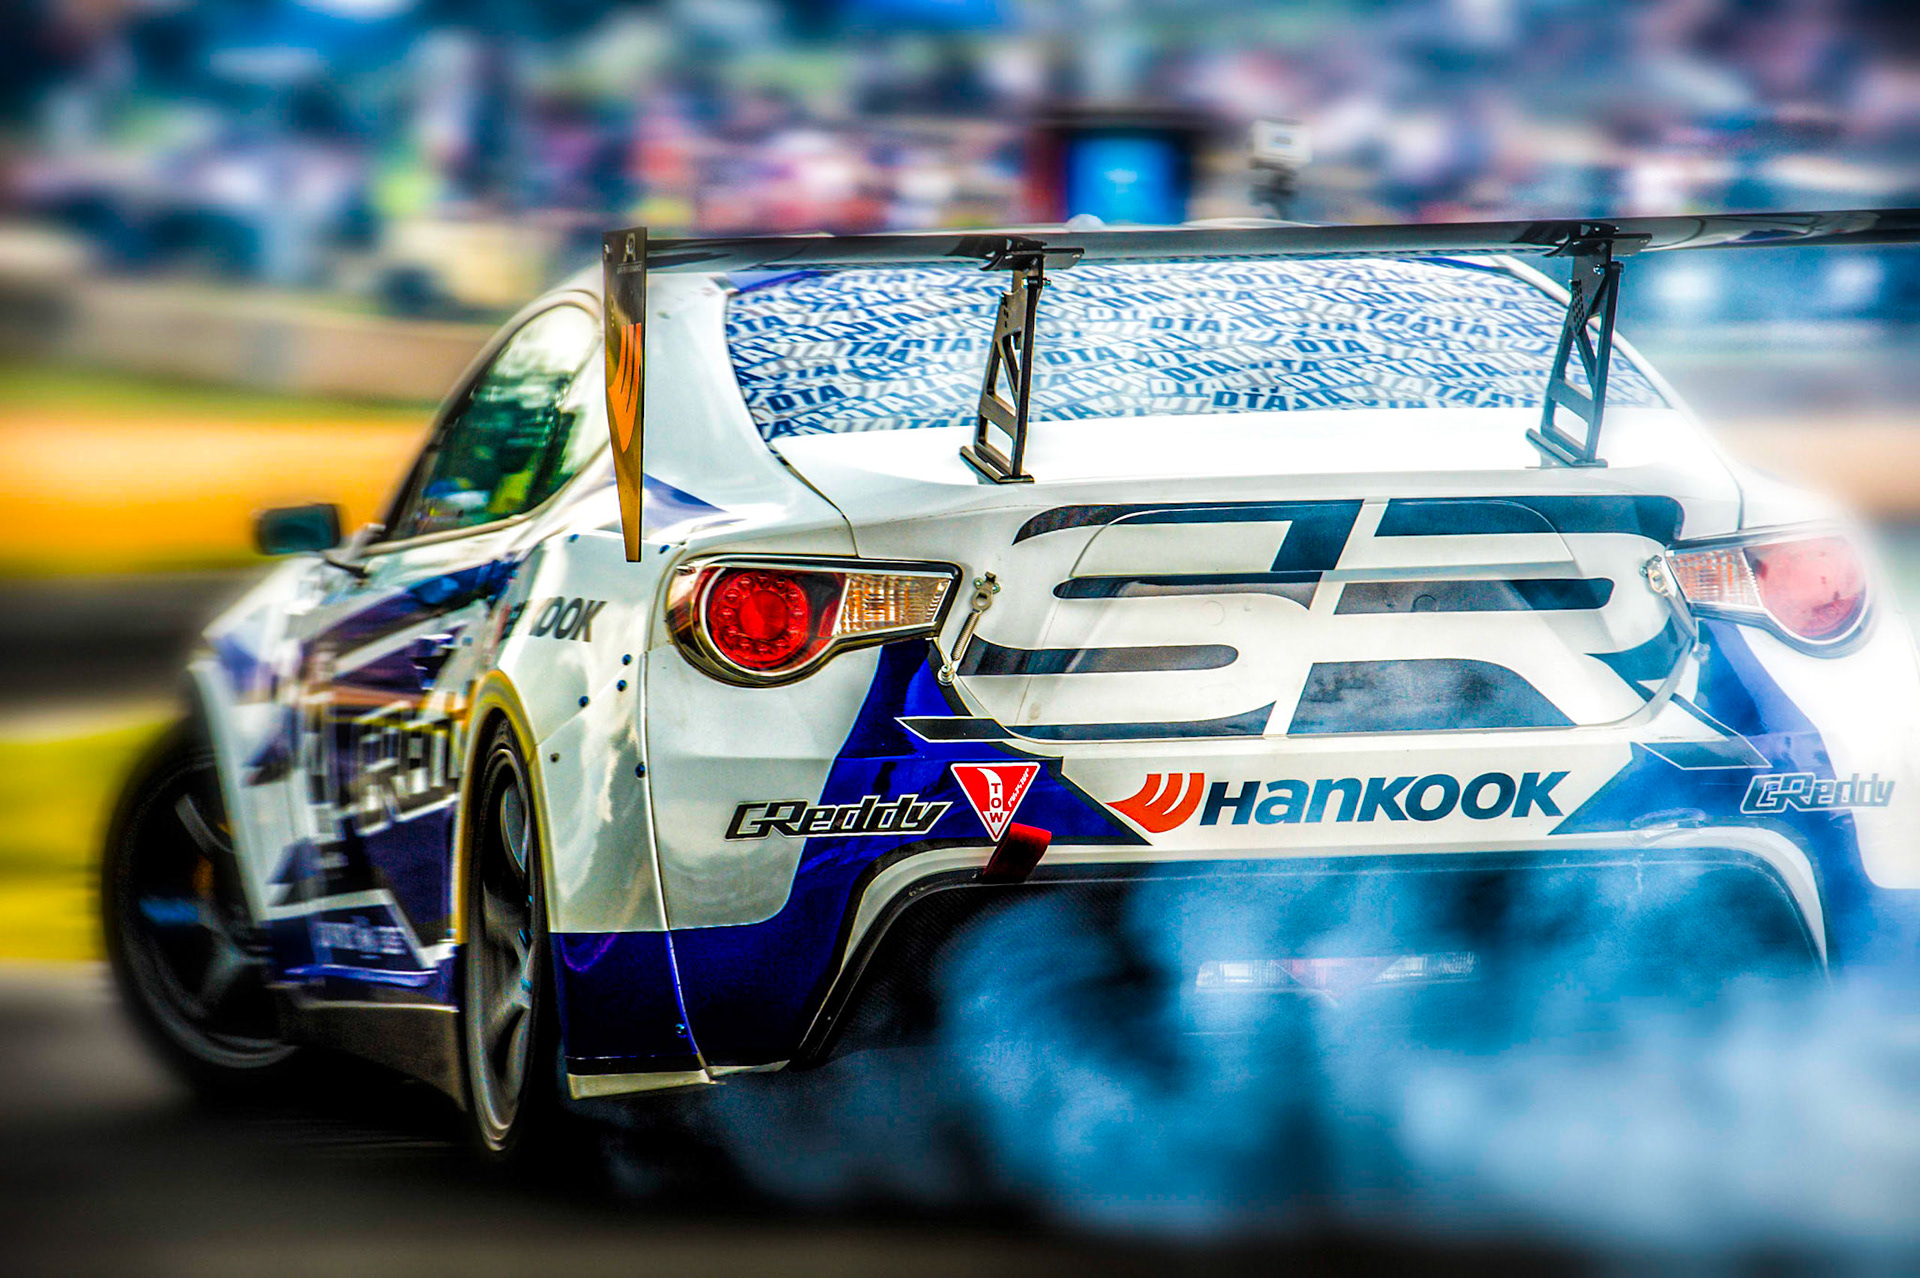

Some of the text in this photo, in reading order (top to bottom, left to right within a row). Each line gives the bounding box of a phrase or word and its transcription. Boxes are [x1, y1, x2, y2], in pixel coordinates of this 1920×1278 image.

[1148, 316, 1223, 333] DTA
[1042, 345, 1123, 366] DTA
[1290, 339, 1373, 353] DTA
[1160, 359, 1242, 382] DTA
[765, 384, 847, 413] DTA
[1212, 389, 1289, 411] DTA
[990, 782, 1004, 824] TOW
[1740, 771, 1896, 815] GReddy
[724, 794, 954, 842] GReddy
